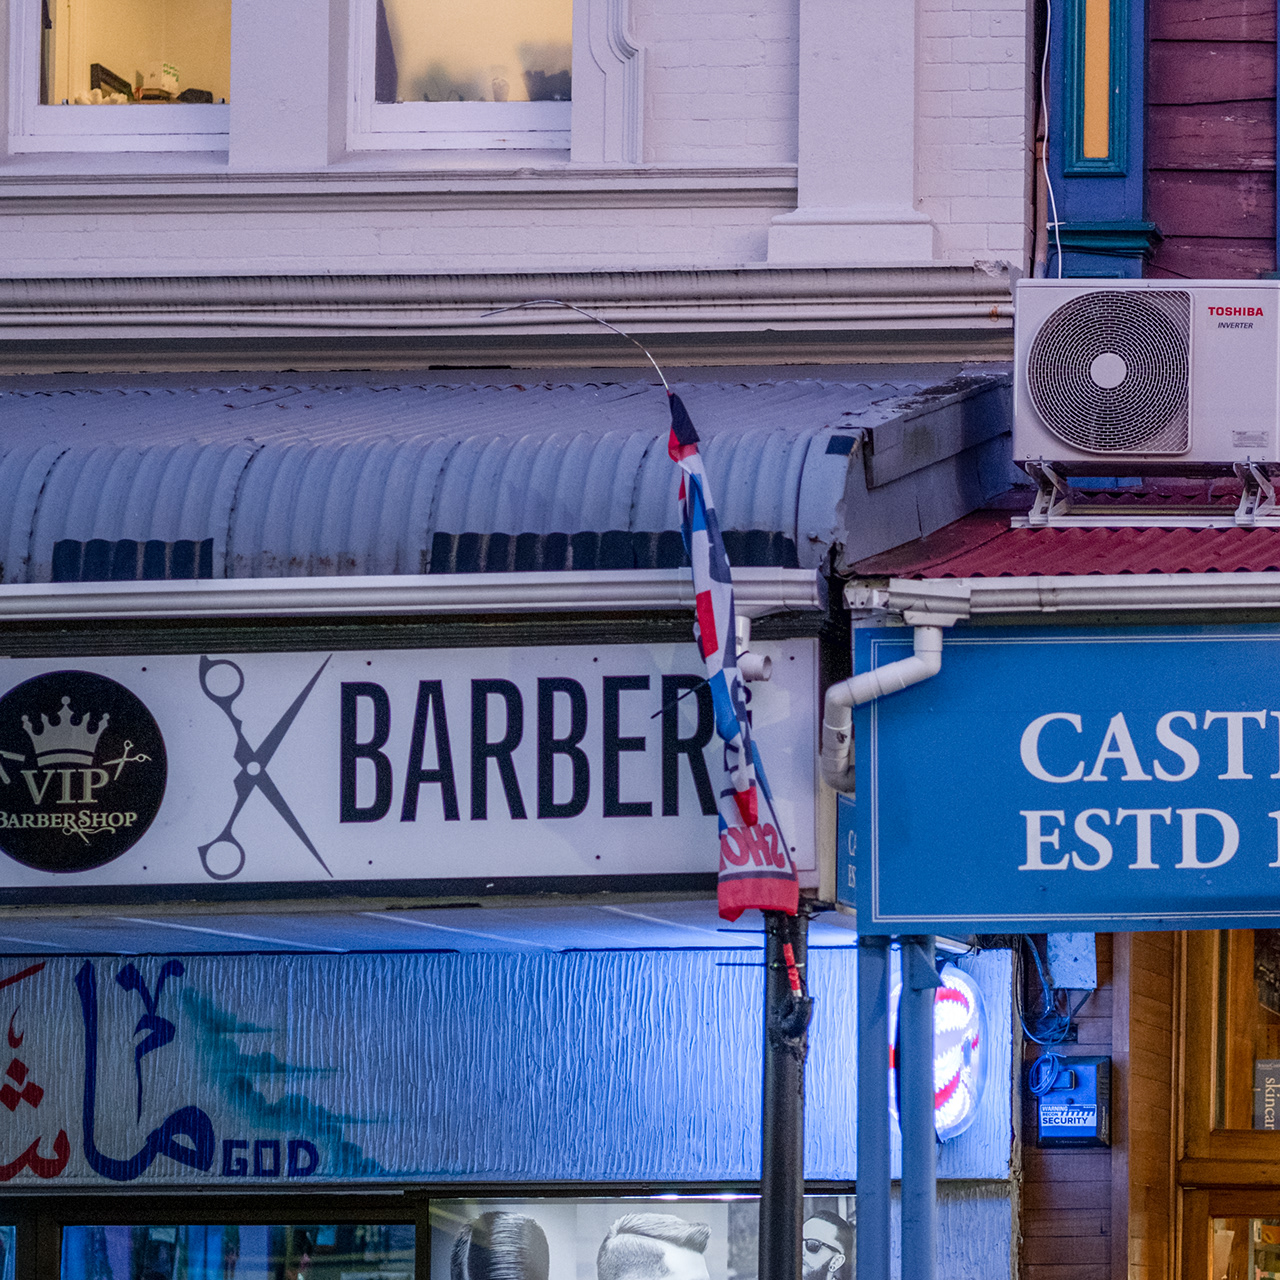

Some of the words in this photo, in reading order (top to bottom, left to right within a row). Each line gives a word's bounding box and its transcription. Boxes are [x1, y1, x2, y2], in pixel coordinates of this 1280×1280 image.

[1208, 306, 1264, 317] TOSHIBA
[1217, 322, 1254, 330] INVERTER
[339, 673, 719, 824] BARBER
[20, 768, 110, 805] VIP
[1017, 806, 1241, 872] ESTD
[222, 1138, 320, 1178] GOD
